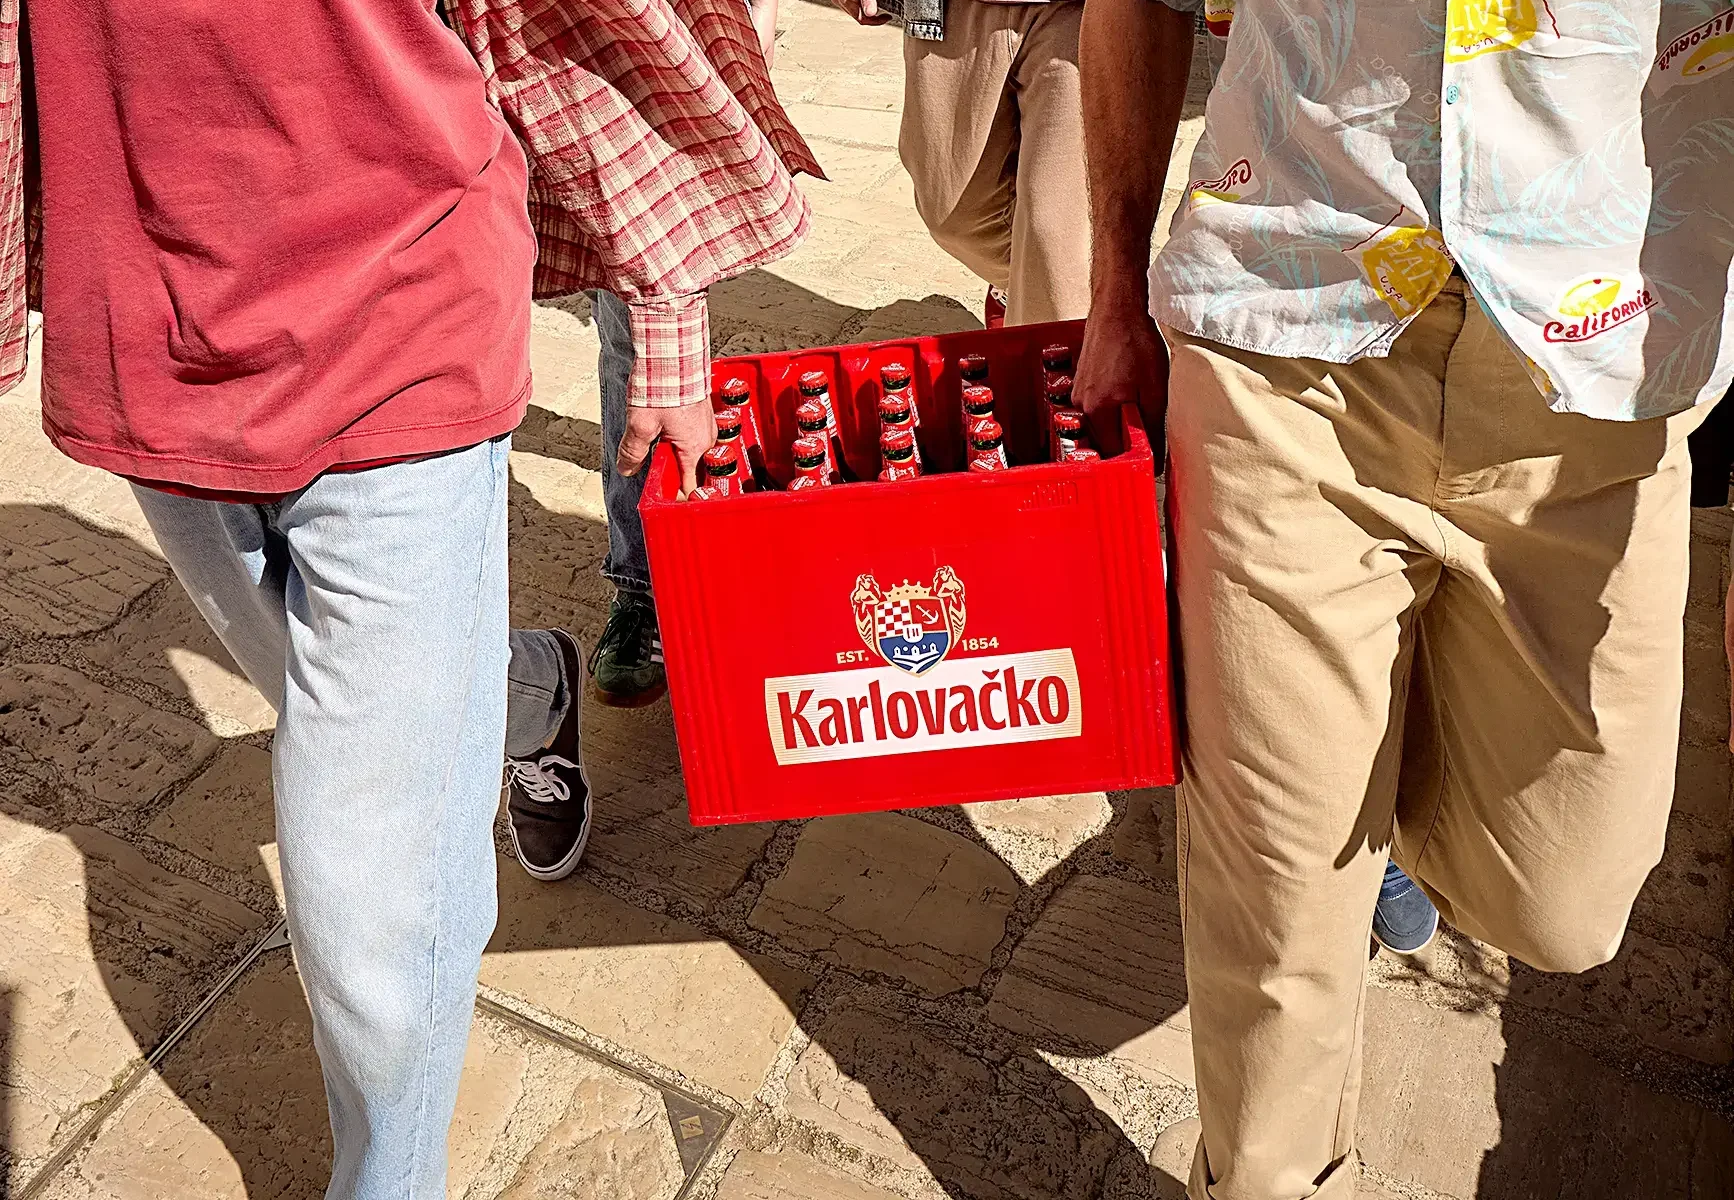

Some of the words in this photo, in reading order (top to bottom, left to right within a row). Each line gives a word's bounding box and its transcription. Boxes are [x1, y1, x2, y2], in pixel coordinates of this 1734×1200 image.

[836, 650, 869, 664] EST.
[961, 637, 1000, 651] 1854
[777, 665, 1070, 750] Karlovačko
